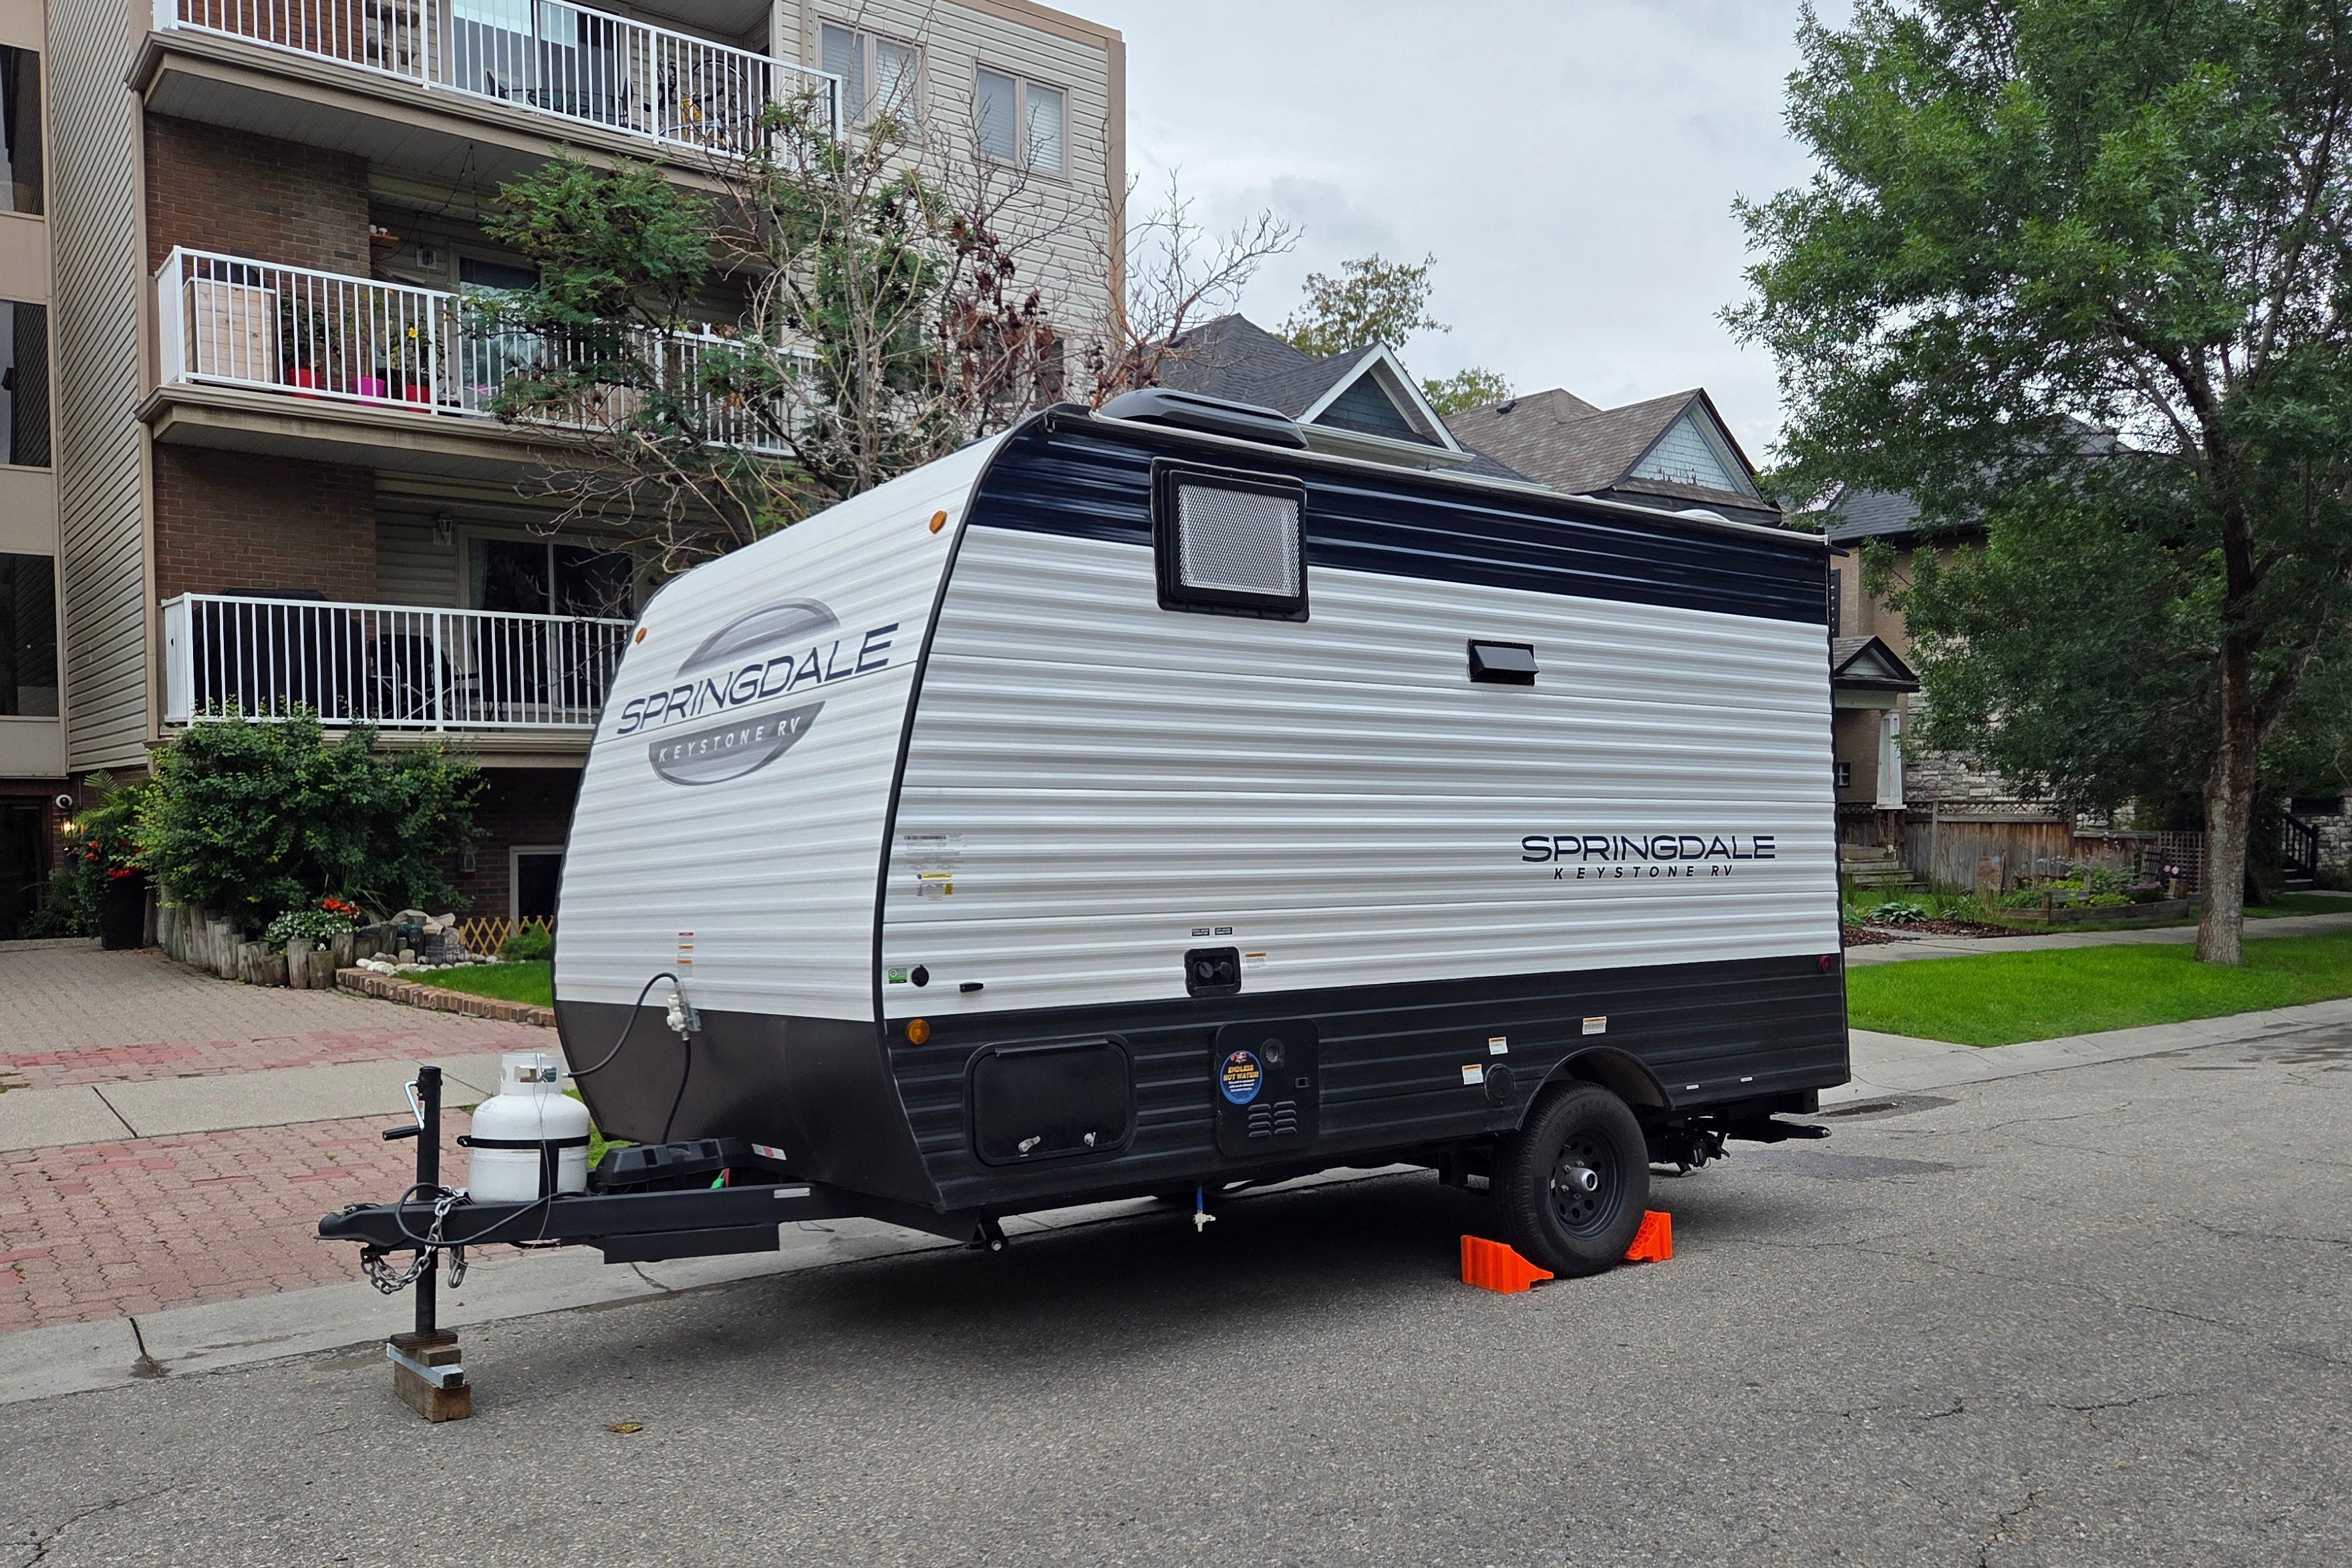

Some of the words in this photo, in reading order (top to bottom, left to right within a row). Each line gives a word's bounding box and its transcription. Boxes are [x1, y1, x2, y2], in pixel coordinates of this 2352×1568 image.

[616, 622, 899, 734] SPRINGDALE
[658, 726, 764, 763] KEYSTONE
[776, 716, 801, 737] RV
[1521, 835, 1776, 862] SPRINGDALE
[1554, 866, 1695, 880] KEYSTONE
[1711, 865, 1733, 877] RV
[1223, 1073, 1236, 1081] HOT
